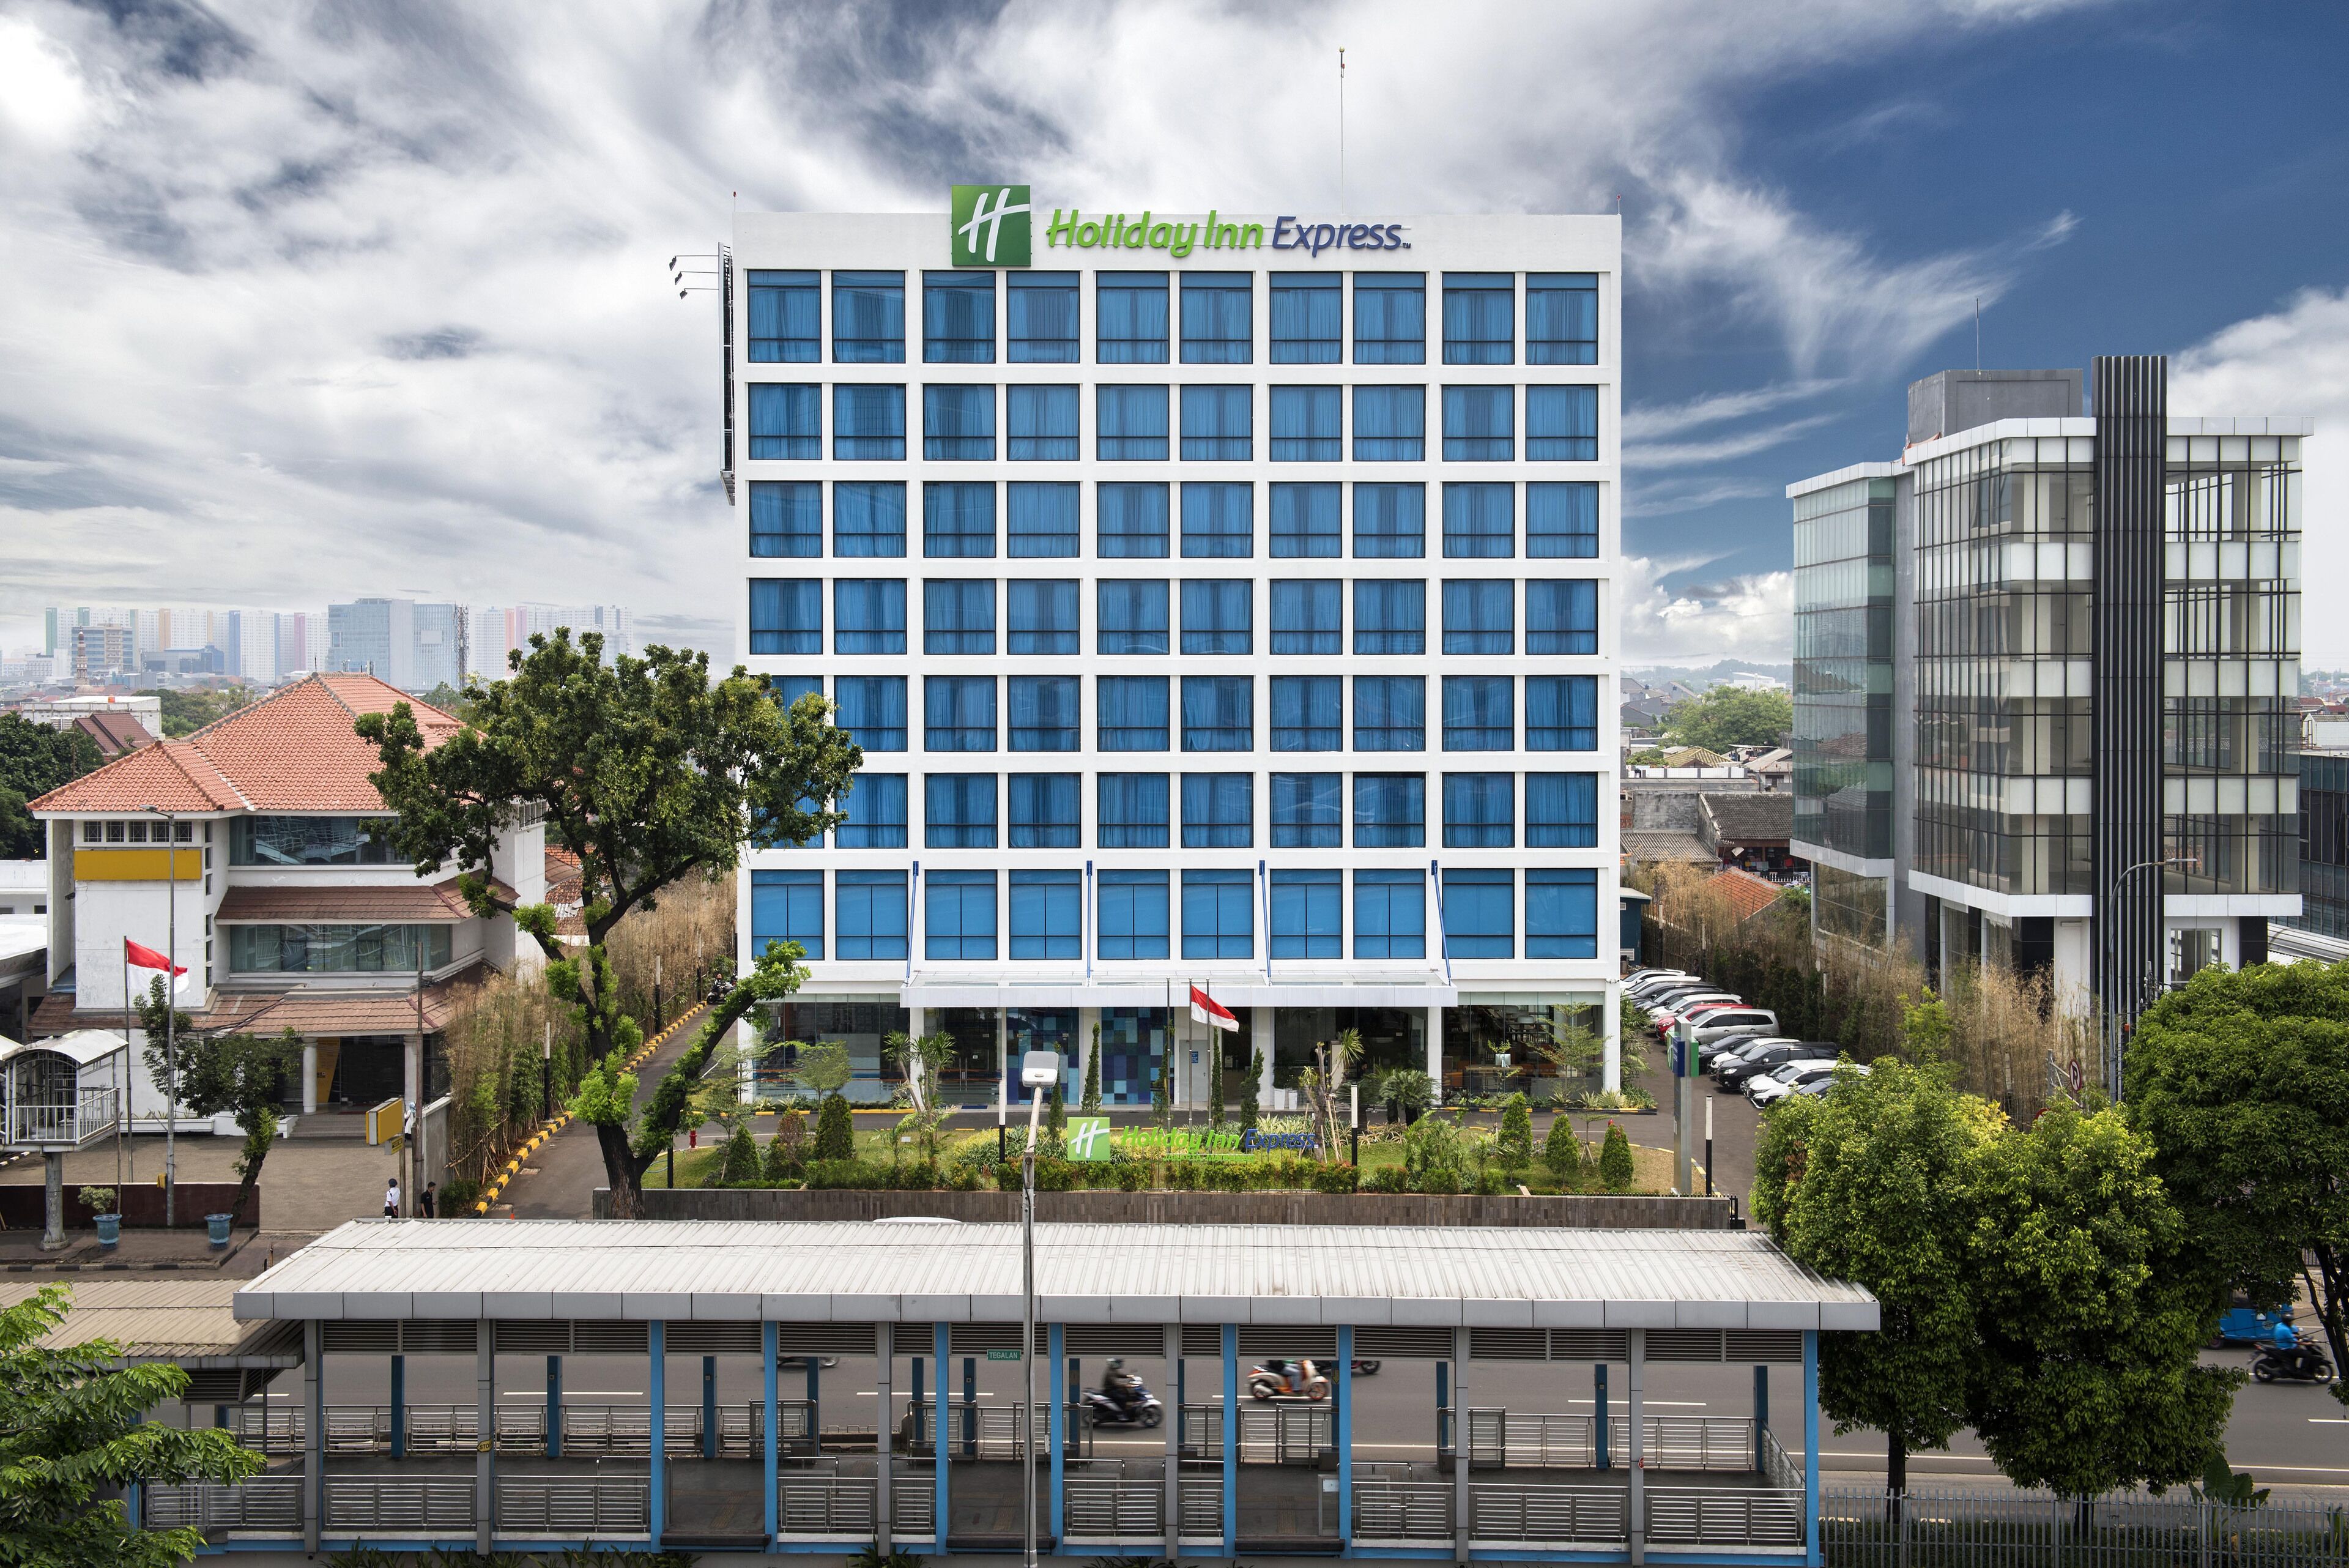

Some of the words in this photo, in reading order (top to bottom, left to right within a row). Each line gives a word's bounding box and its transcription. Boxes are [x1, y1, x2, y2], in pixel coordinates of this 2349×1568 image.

[1045, 209, 1198, 258] Holiday
[1204, 210, 1264, 249] Inn
[1272, 215, 1402, 258] Express
[1121, 1126, 1203, 1153] Holiday
[1204, 1129, 1240, 1150] Inn
[1245, 1128, 1315, 1153] Express
